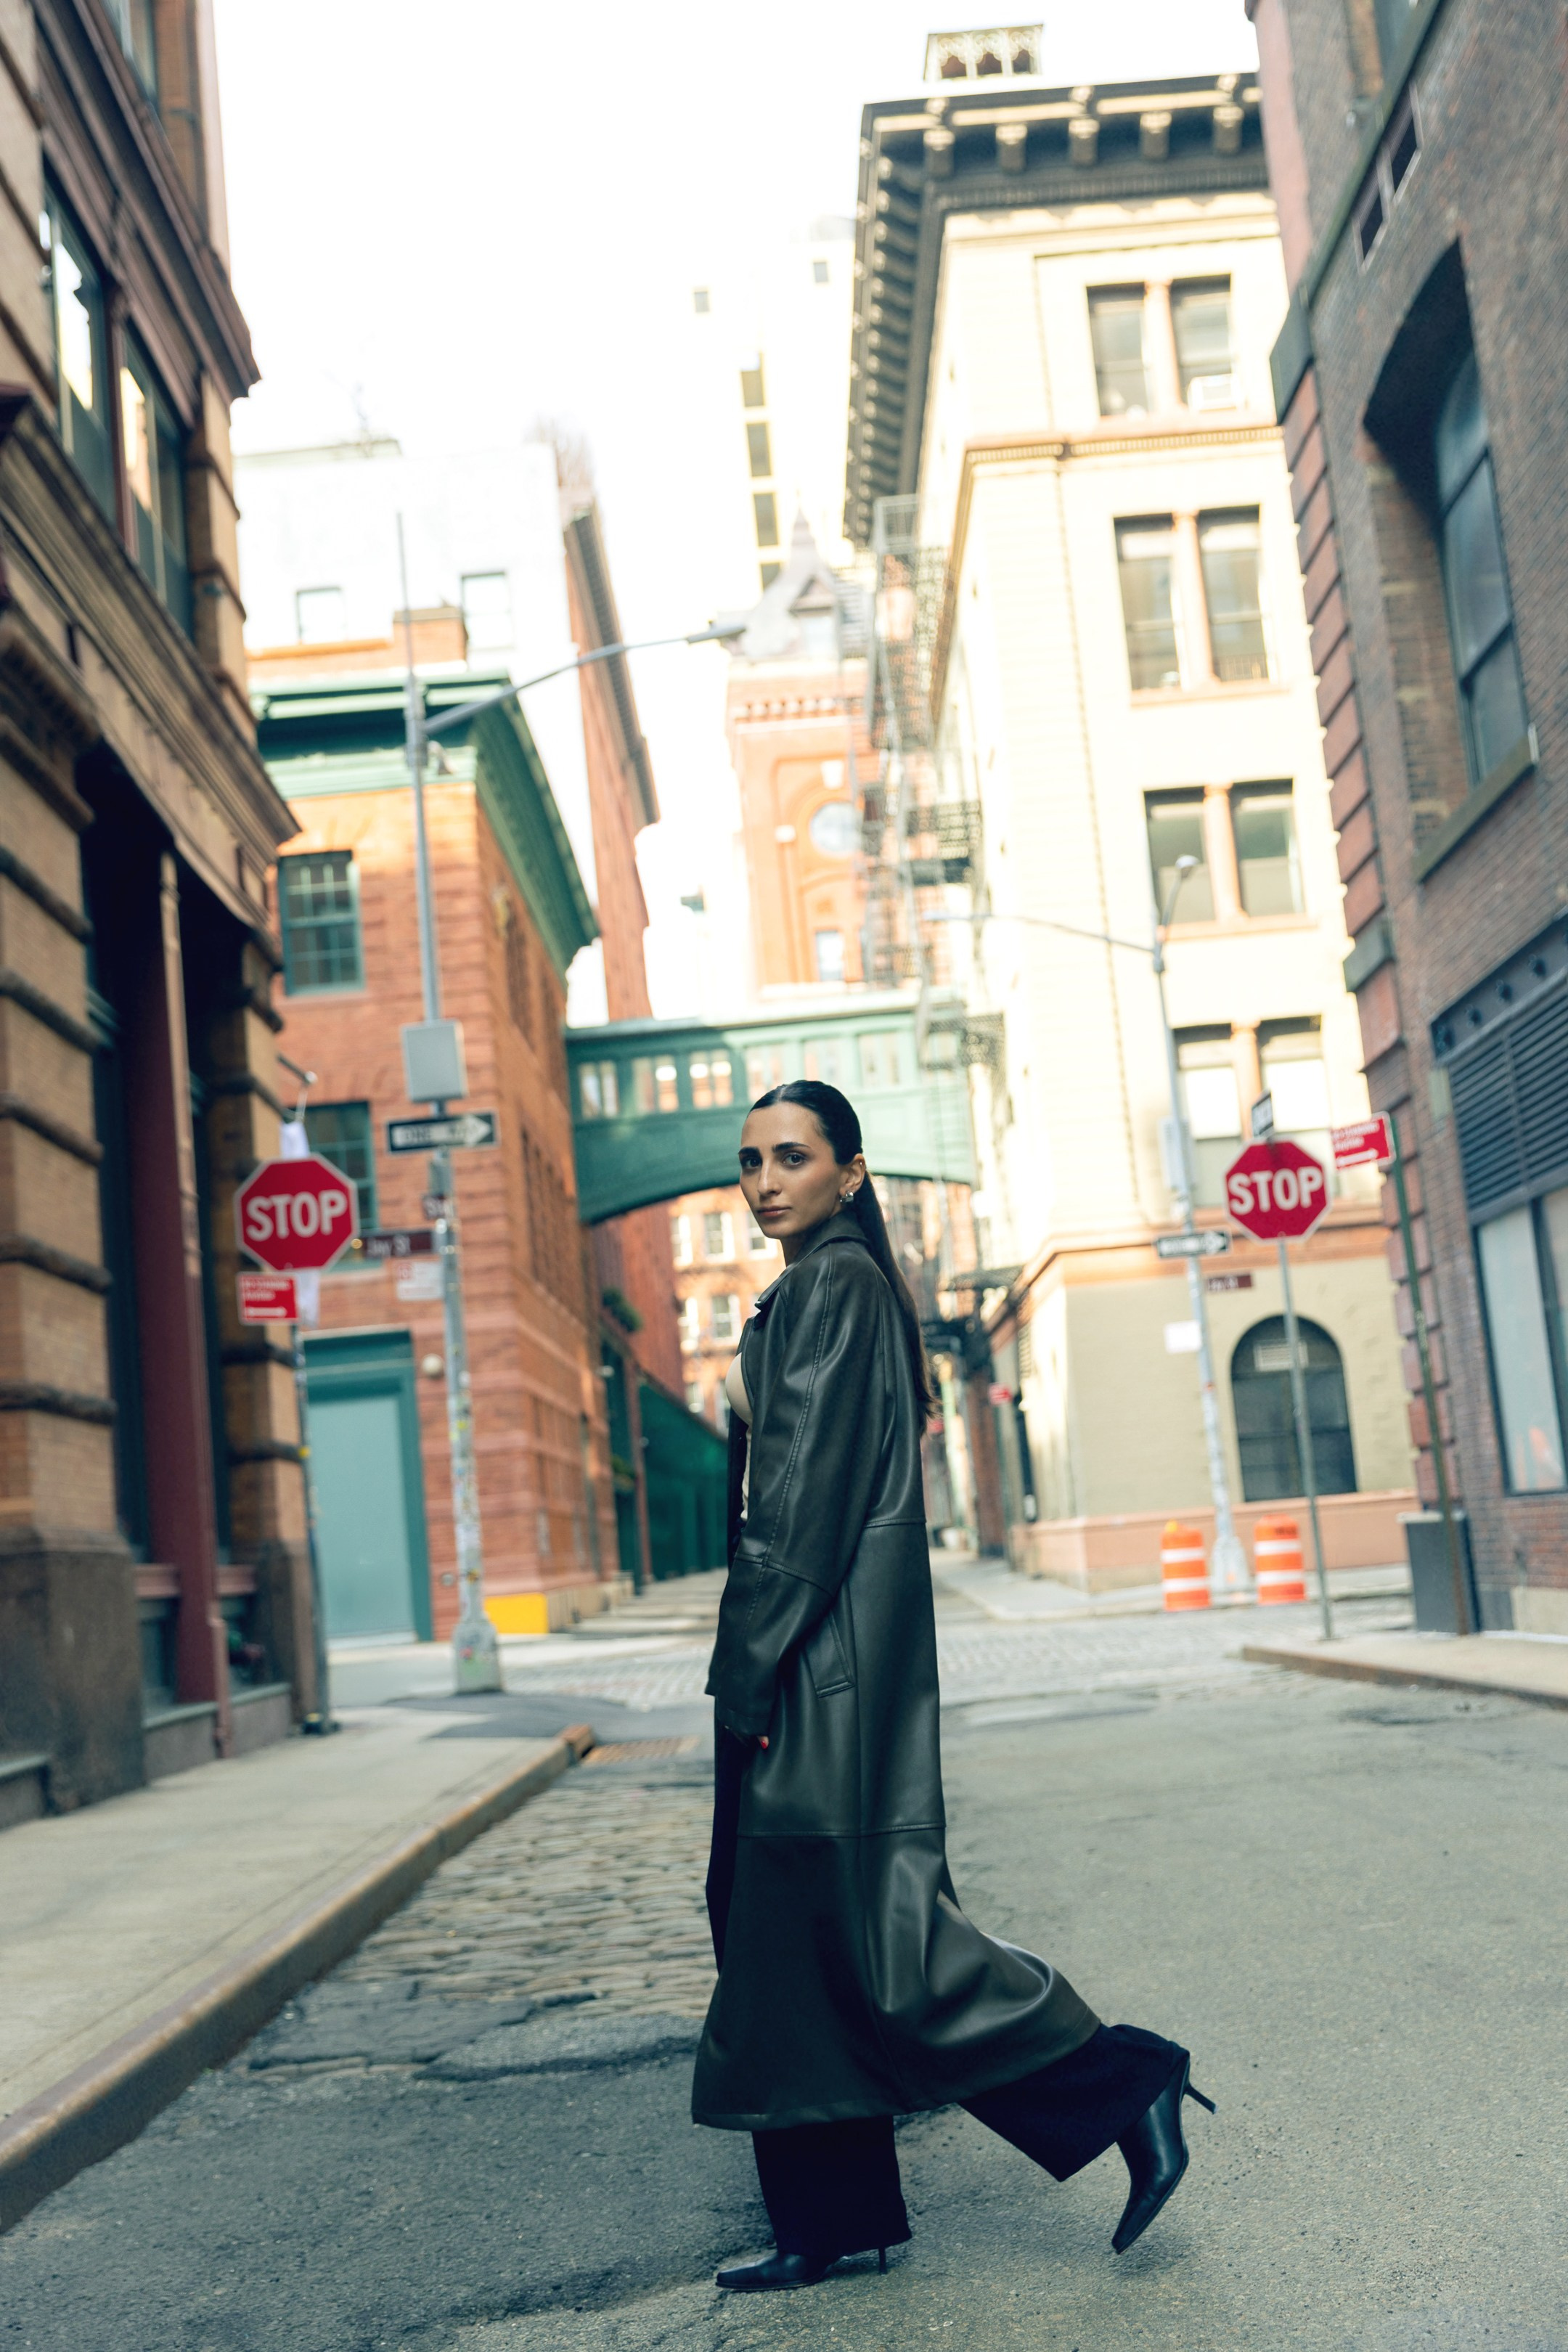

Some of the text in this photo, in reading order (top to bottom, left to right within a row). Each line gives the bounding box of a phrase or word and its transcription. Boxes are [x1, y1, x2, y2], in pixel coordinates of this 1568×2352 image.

[247, 1189, 348, 1241] STOP
[1228, 1165, 1323, 1215] STOP
[366, 1235, 411, 1258] Jay St
